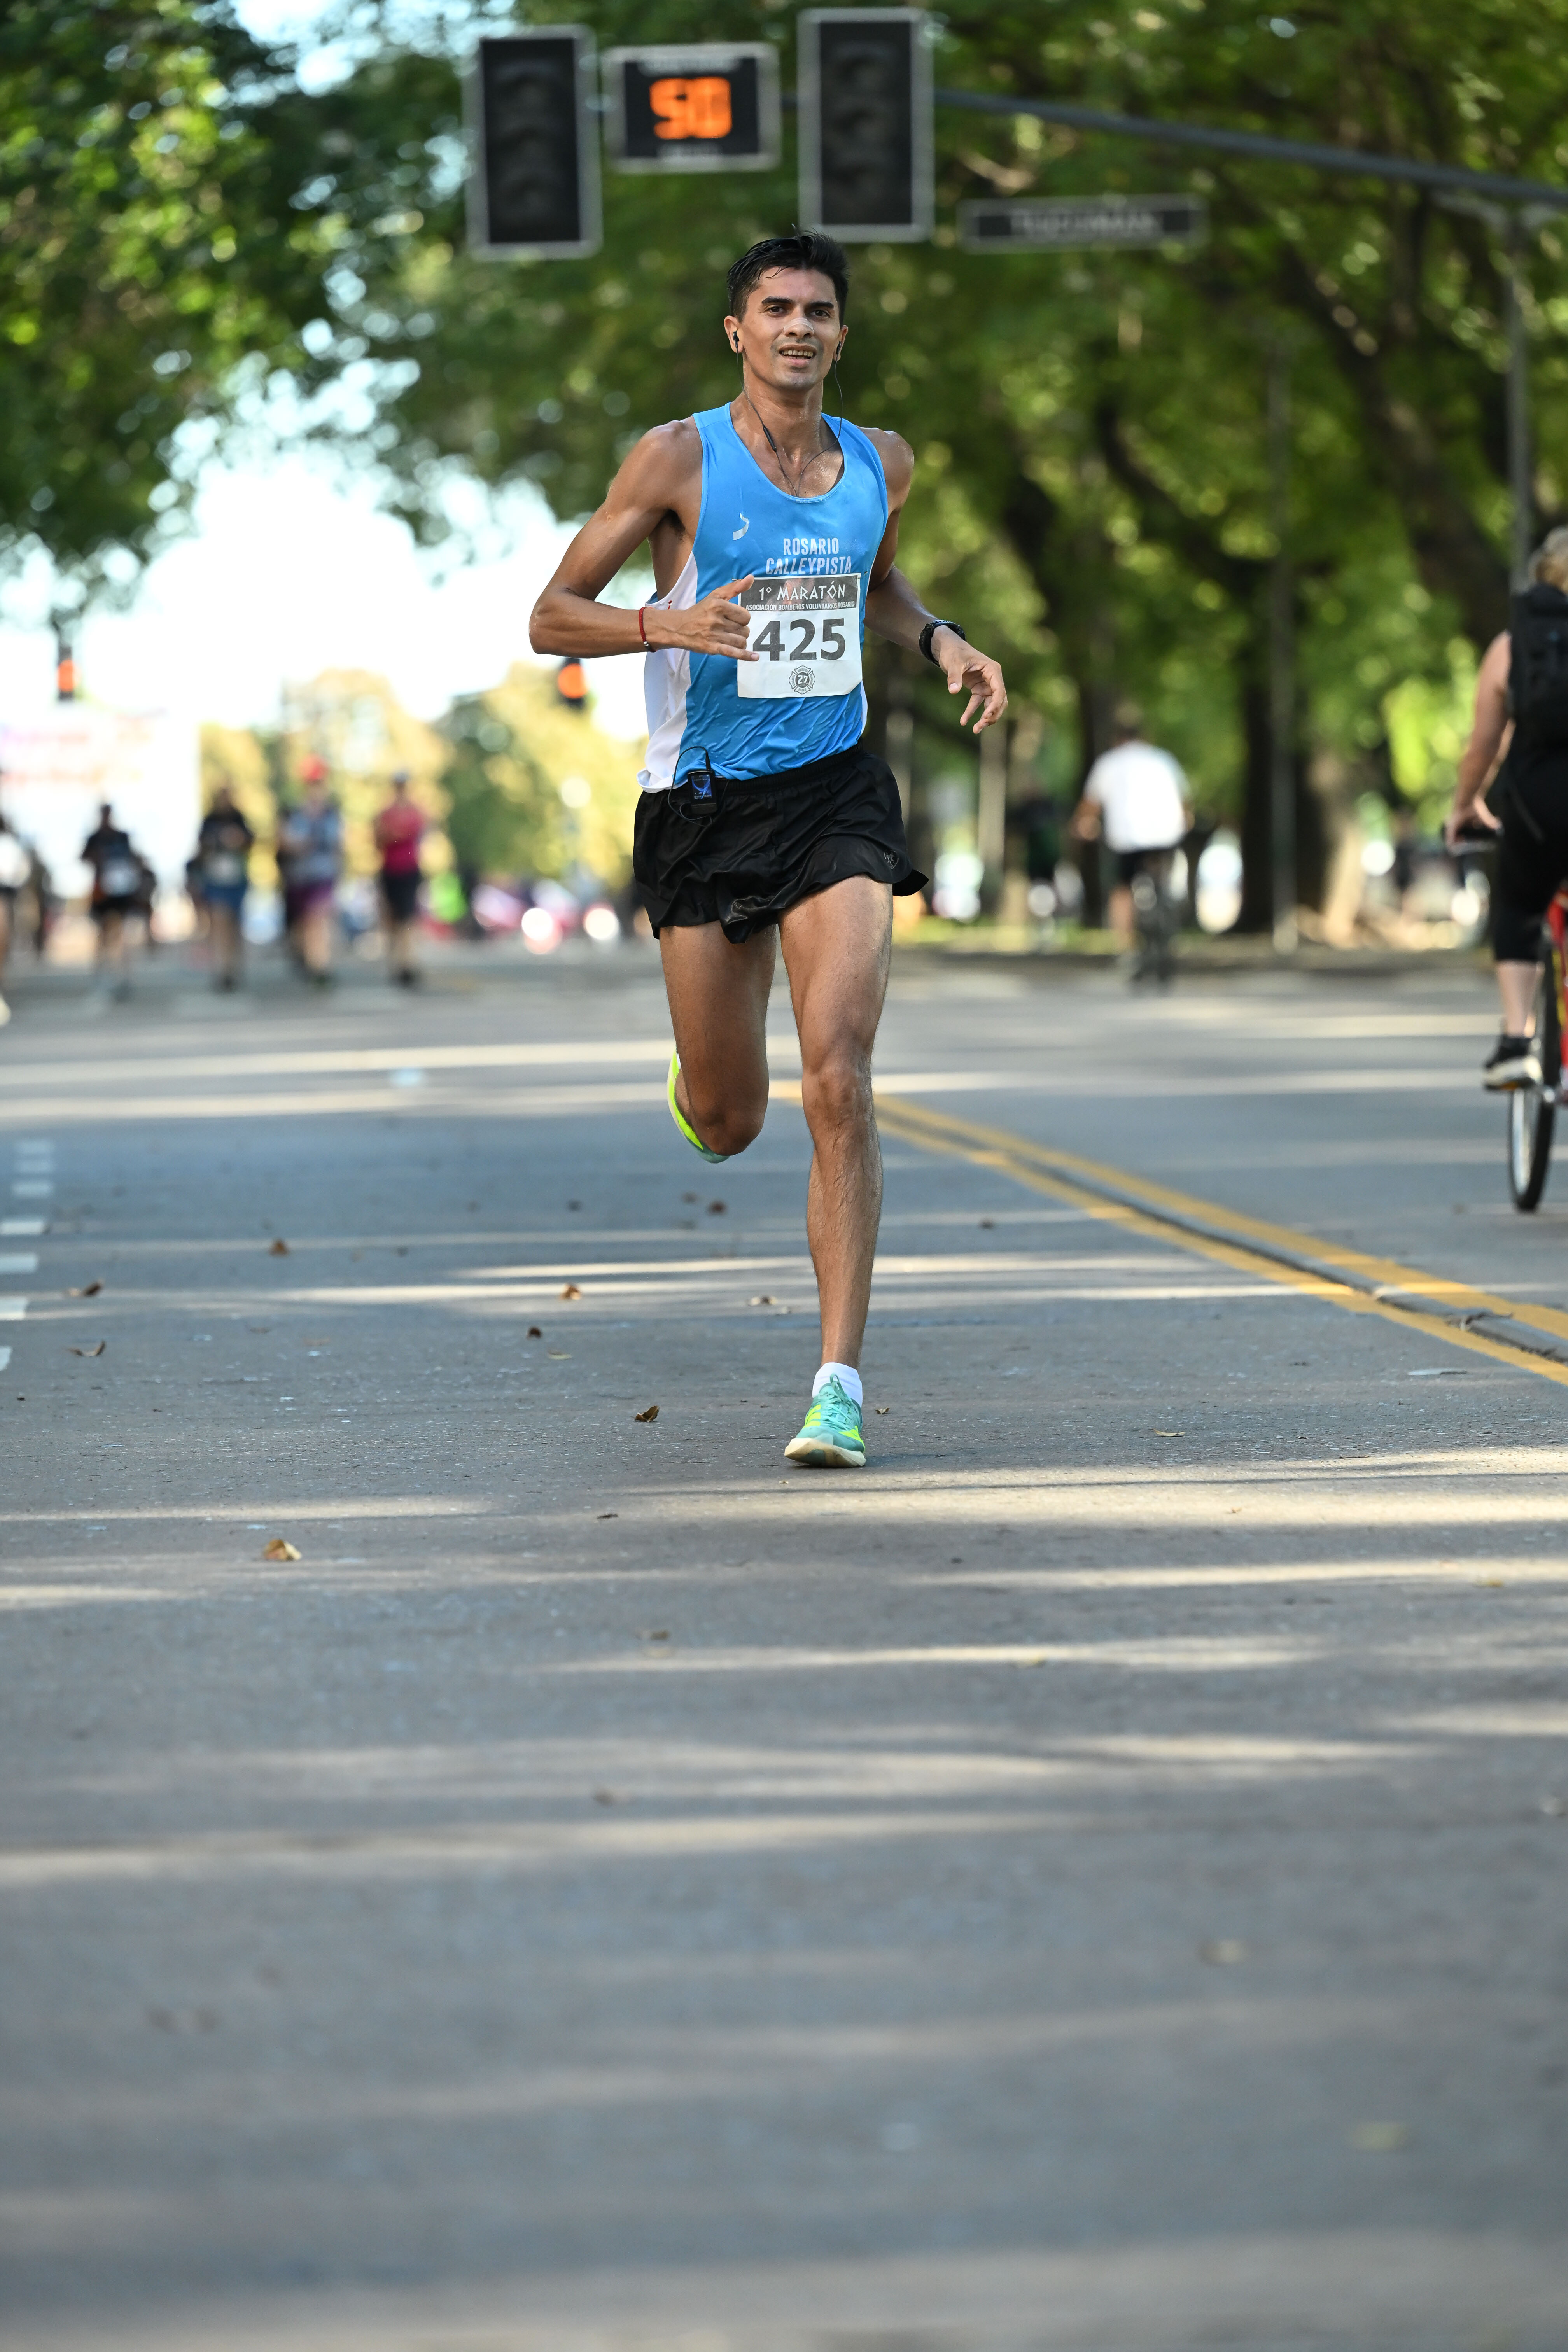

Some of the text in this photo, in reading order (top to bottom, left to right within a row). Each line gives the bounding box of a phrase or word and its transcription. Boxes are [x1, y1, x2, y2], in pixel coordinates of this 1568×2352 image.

[783, 538, 839, 555] ROSARIO
[766, 556, 852, 575] CALLEYPISTA
[777, 581, 846, 601] MARATÓN
[752, 618, 845, 661] 425
[798, 674, 808, 684] 27
